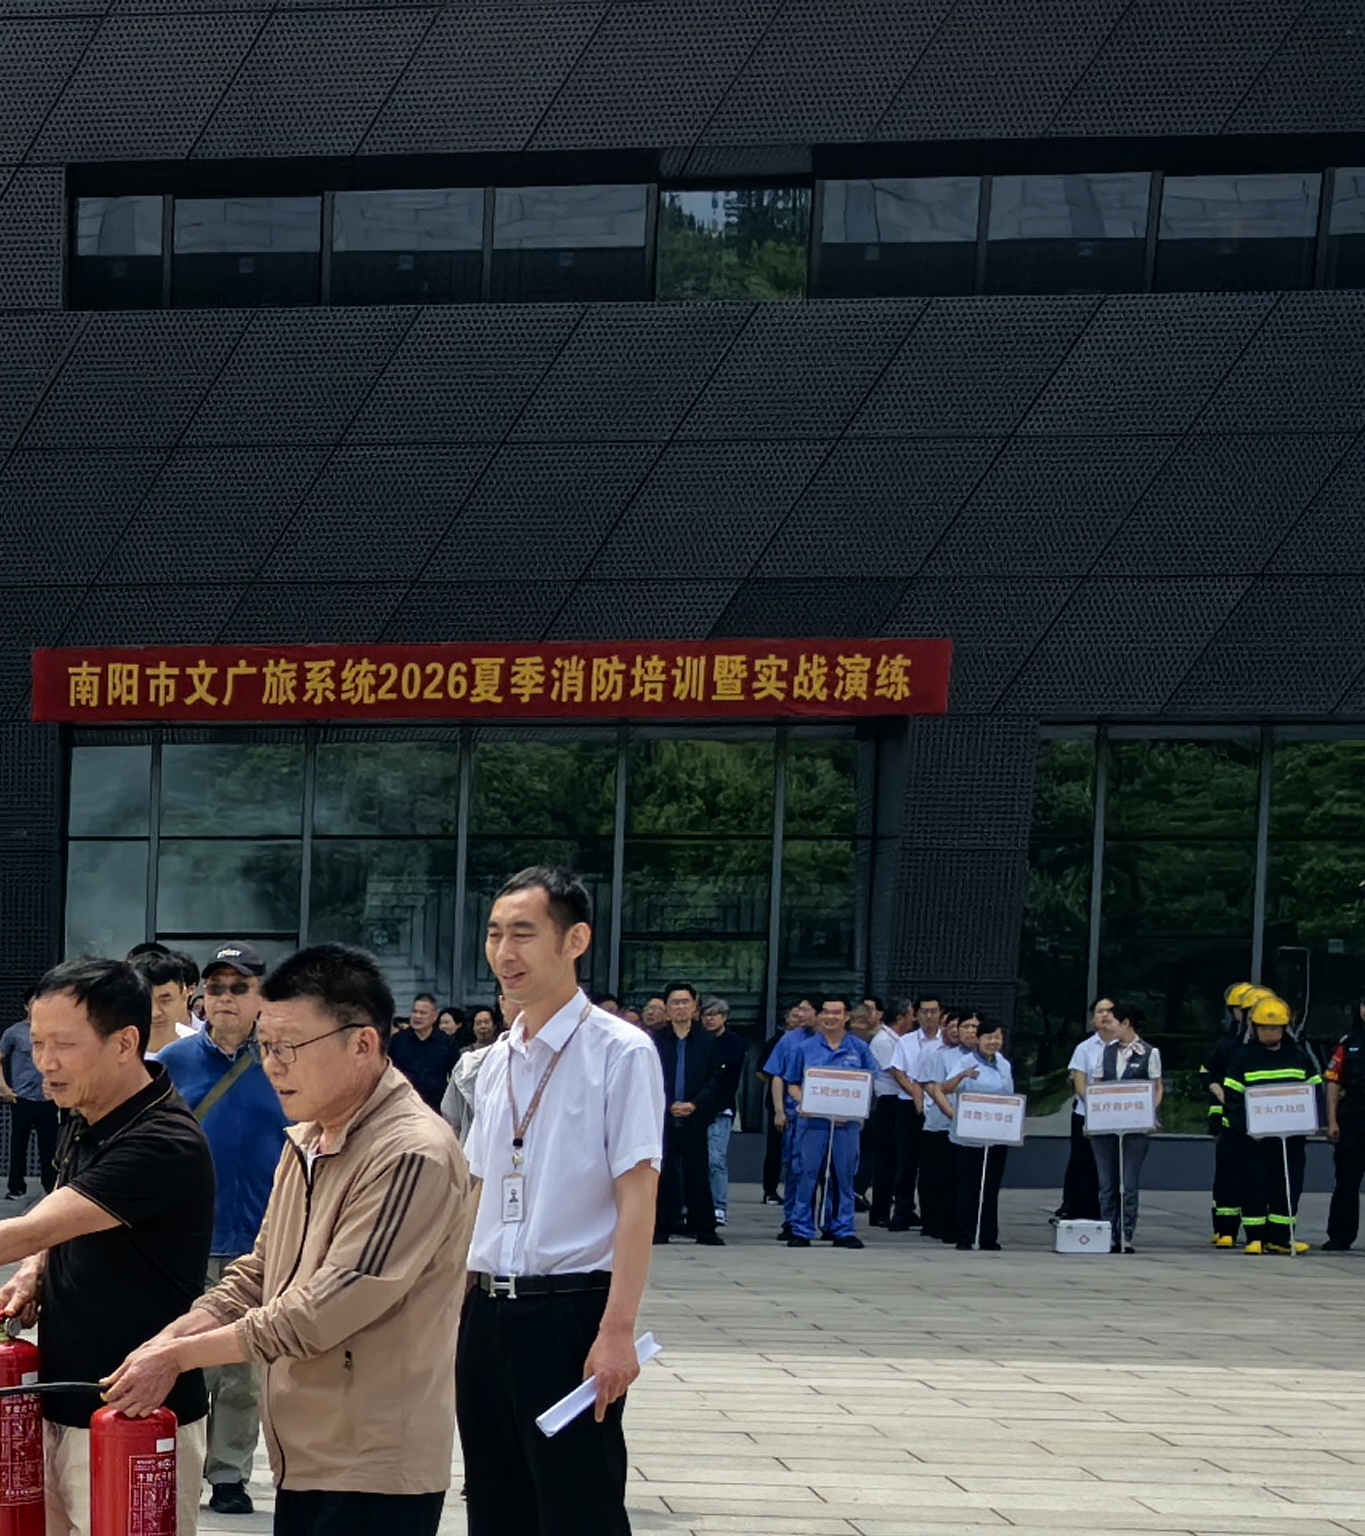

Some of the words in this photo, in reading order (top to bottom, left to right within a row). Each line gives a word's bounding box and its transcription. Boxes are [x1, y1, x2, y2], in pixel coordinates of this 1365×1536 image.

[67, 653, 912, 708] 南阳市文广旅系统2026夏季消防培训暨实战演练
